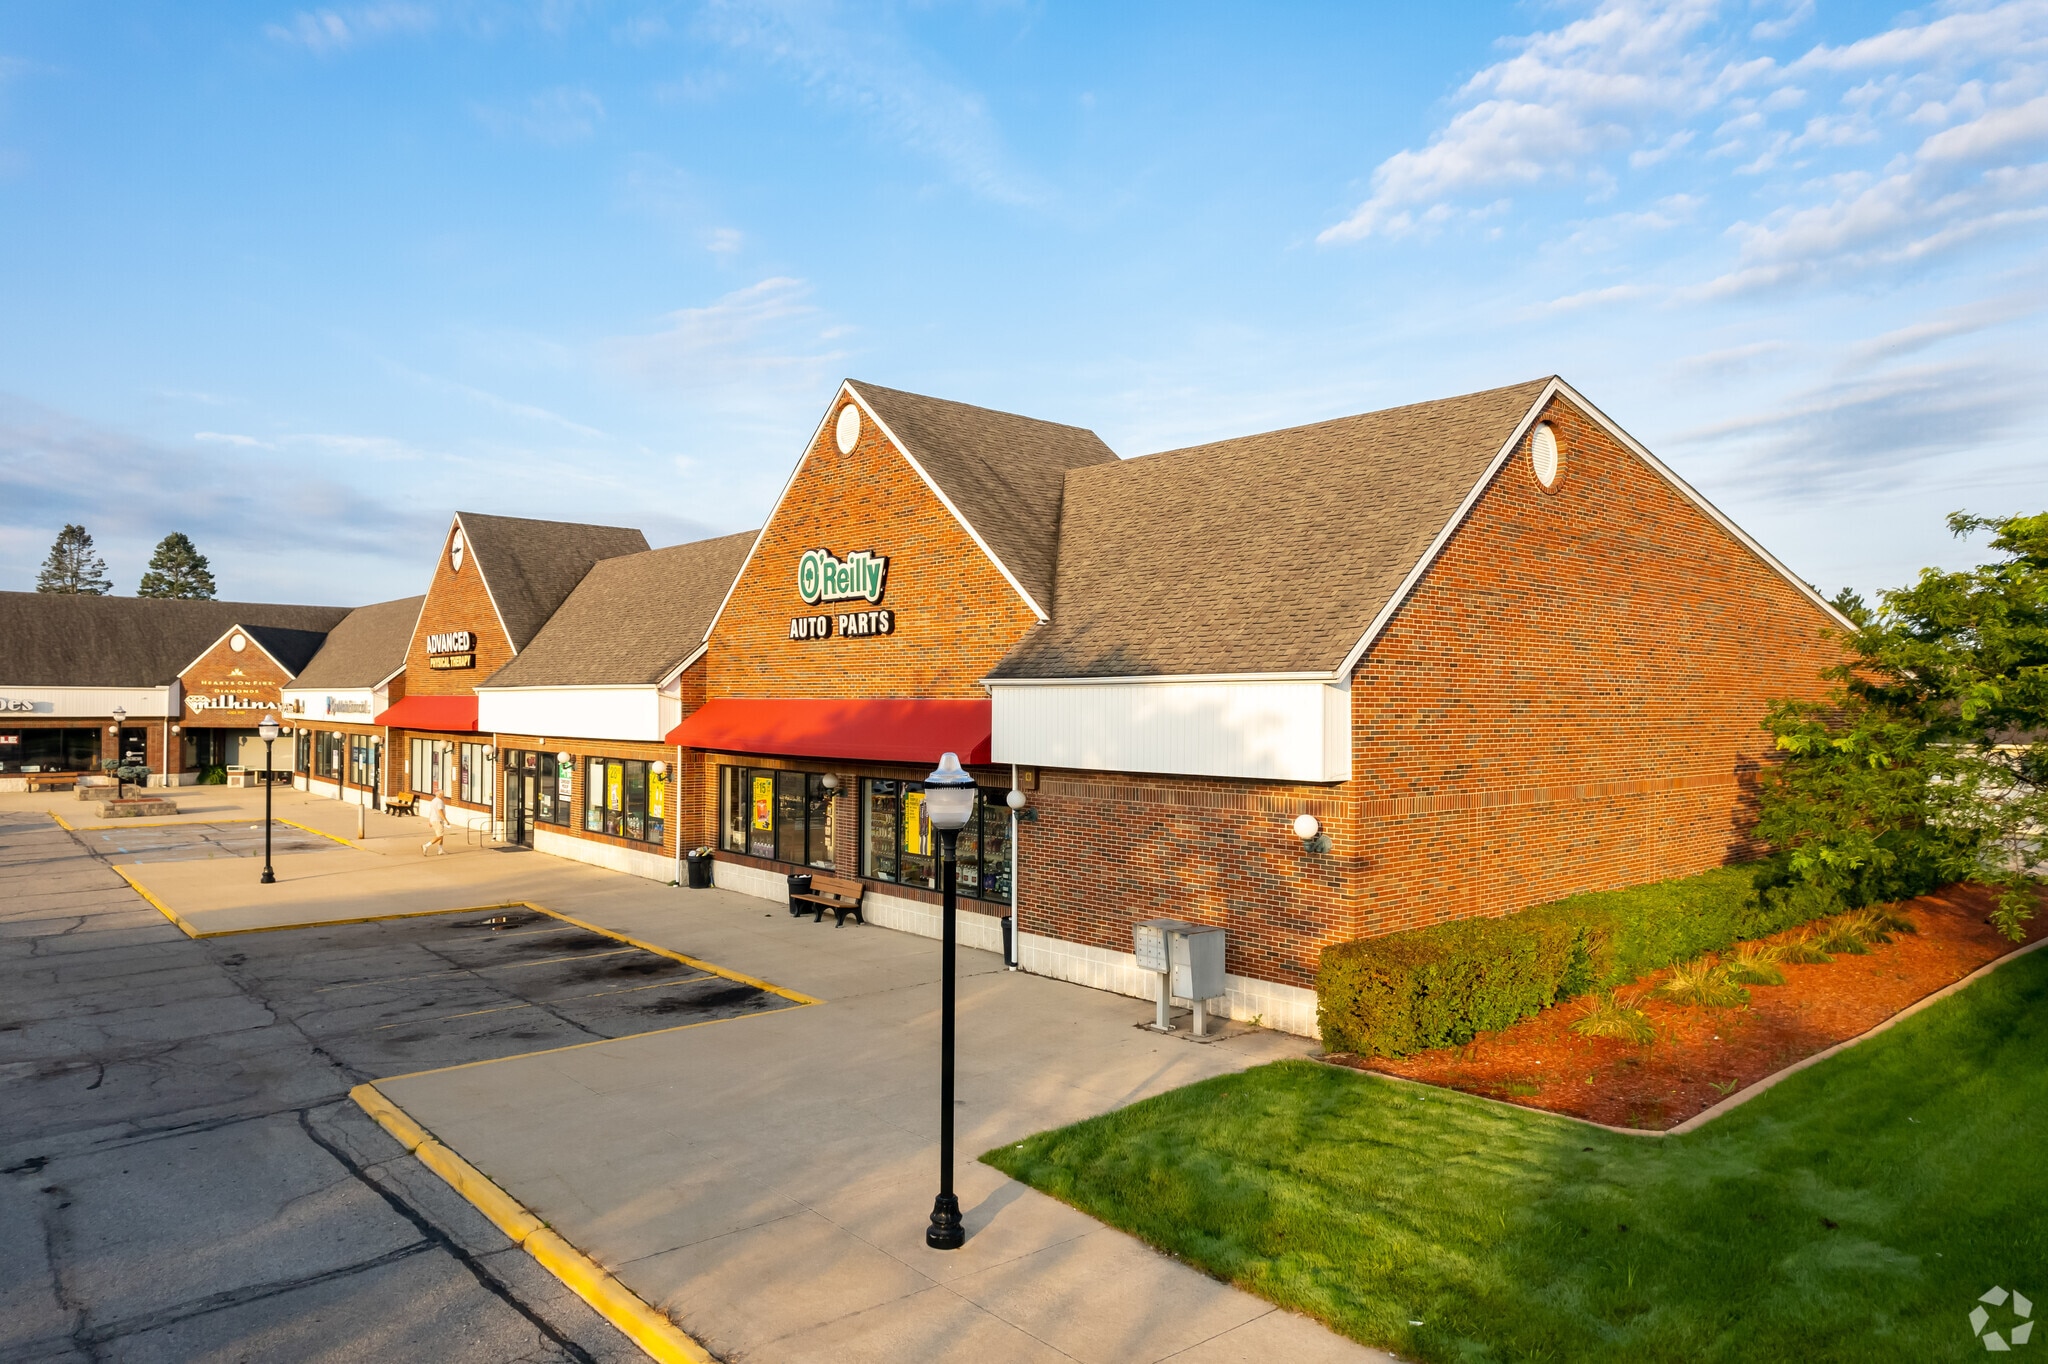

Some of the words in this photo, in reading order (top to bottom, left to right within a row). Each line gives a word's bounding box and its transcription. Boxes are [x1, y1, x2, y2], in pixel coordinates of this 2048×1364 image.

[799, 552, 882, 600] O'Reilly
[789, 616, 828, 639] AUTO
[838, 610, 890, 635] PARTS
[426, 631, 471, 654] ADVANCED
[430, 656, 450, 668] PHYSICAL
[450, 655, 471, 667] THERAPY
